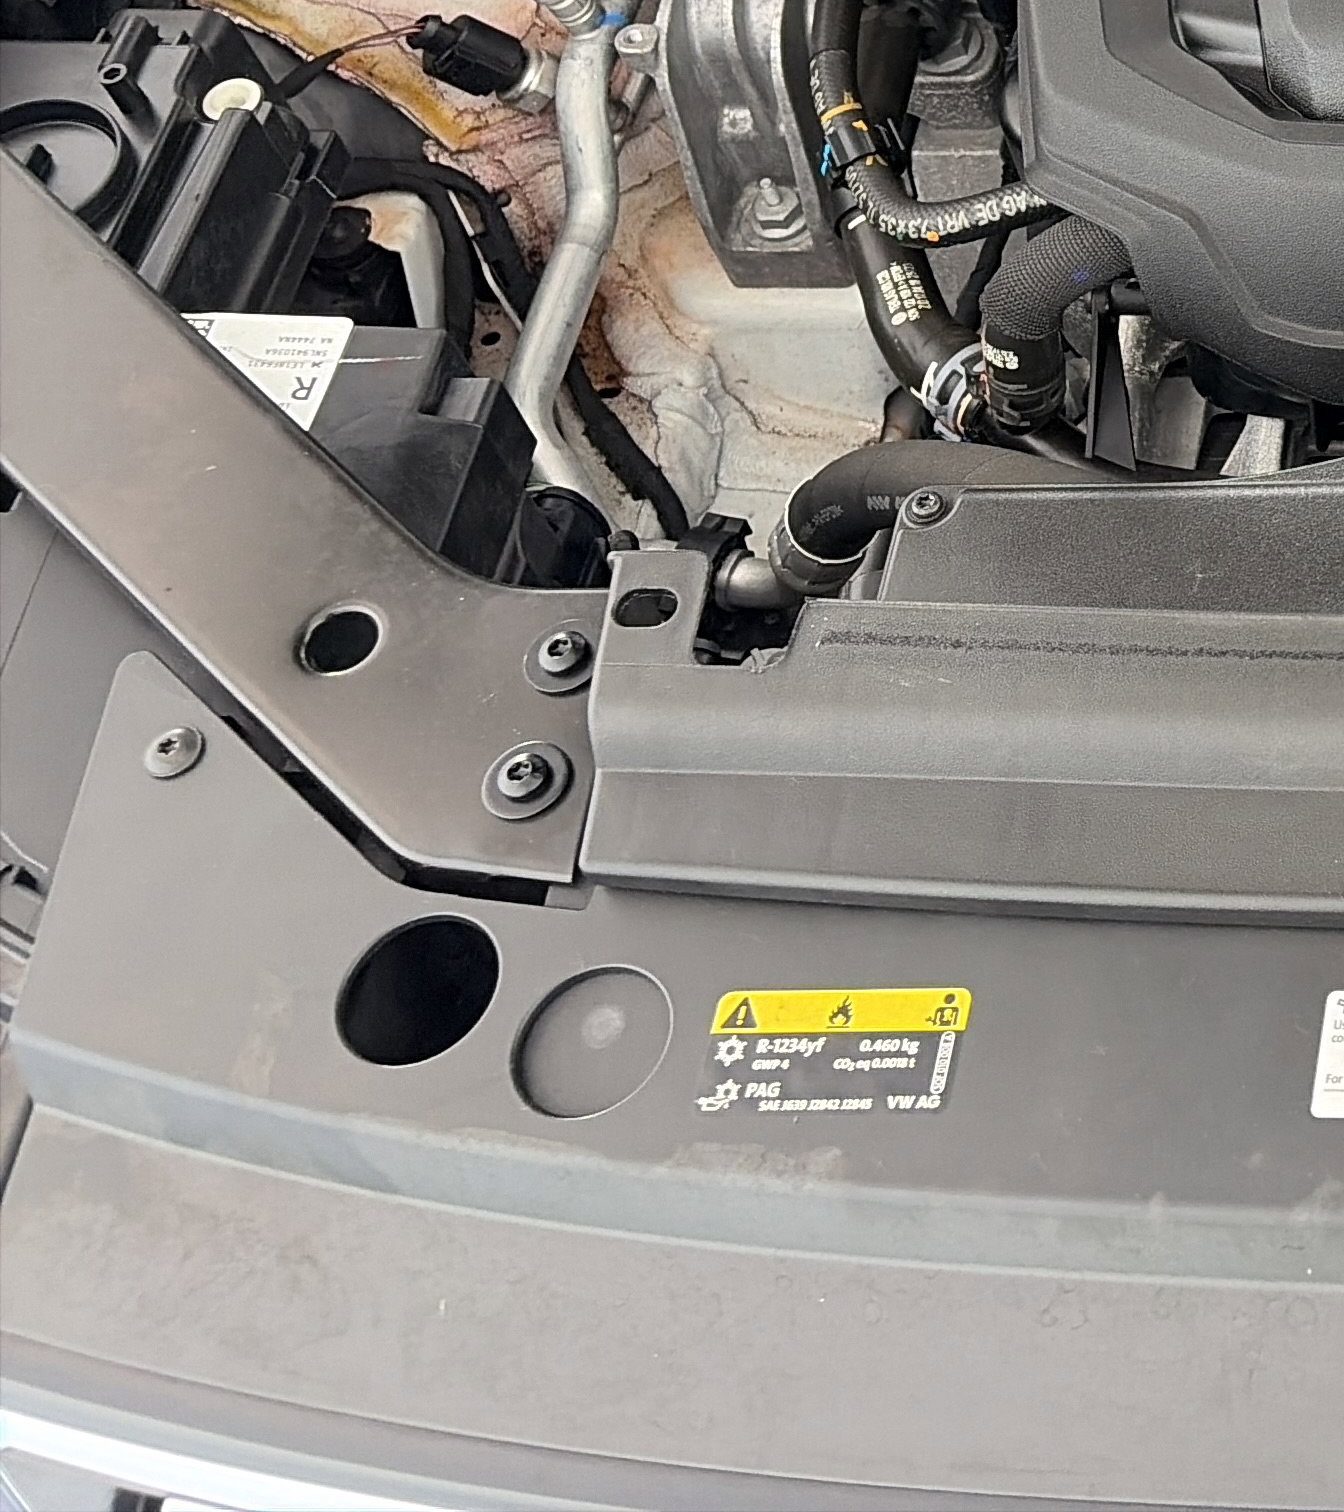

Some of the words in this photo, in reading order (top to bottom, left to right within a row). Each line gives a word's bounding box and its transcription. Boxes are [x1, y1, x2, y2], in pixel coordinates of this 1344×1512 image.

[1002, 191, 1027, 216] AG
[975, 203, 1001, 226] DE
[291, 377, 318, 400] R
[756, 1037, 827, 1057] R-1234yf
[859, 1039, 901, 1052] 0.460
[901, 1038, 920, 1055] kg
[752, 1059, 779, 1070] GWP
[780, 1059, 790, 1069] 4
[856, 1060, 871, 1071] eq
[909, 1058, 916, 1068] t
[1325, 1074, 1343, 1085] For
[745, 1082, 781, 1097] PAG
[758, 1100, 781, 1111] SAE
[887, 1095, 916, 1109] VW
[915, 1094, 941, 1109] AG
